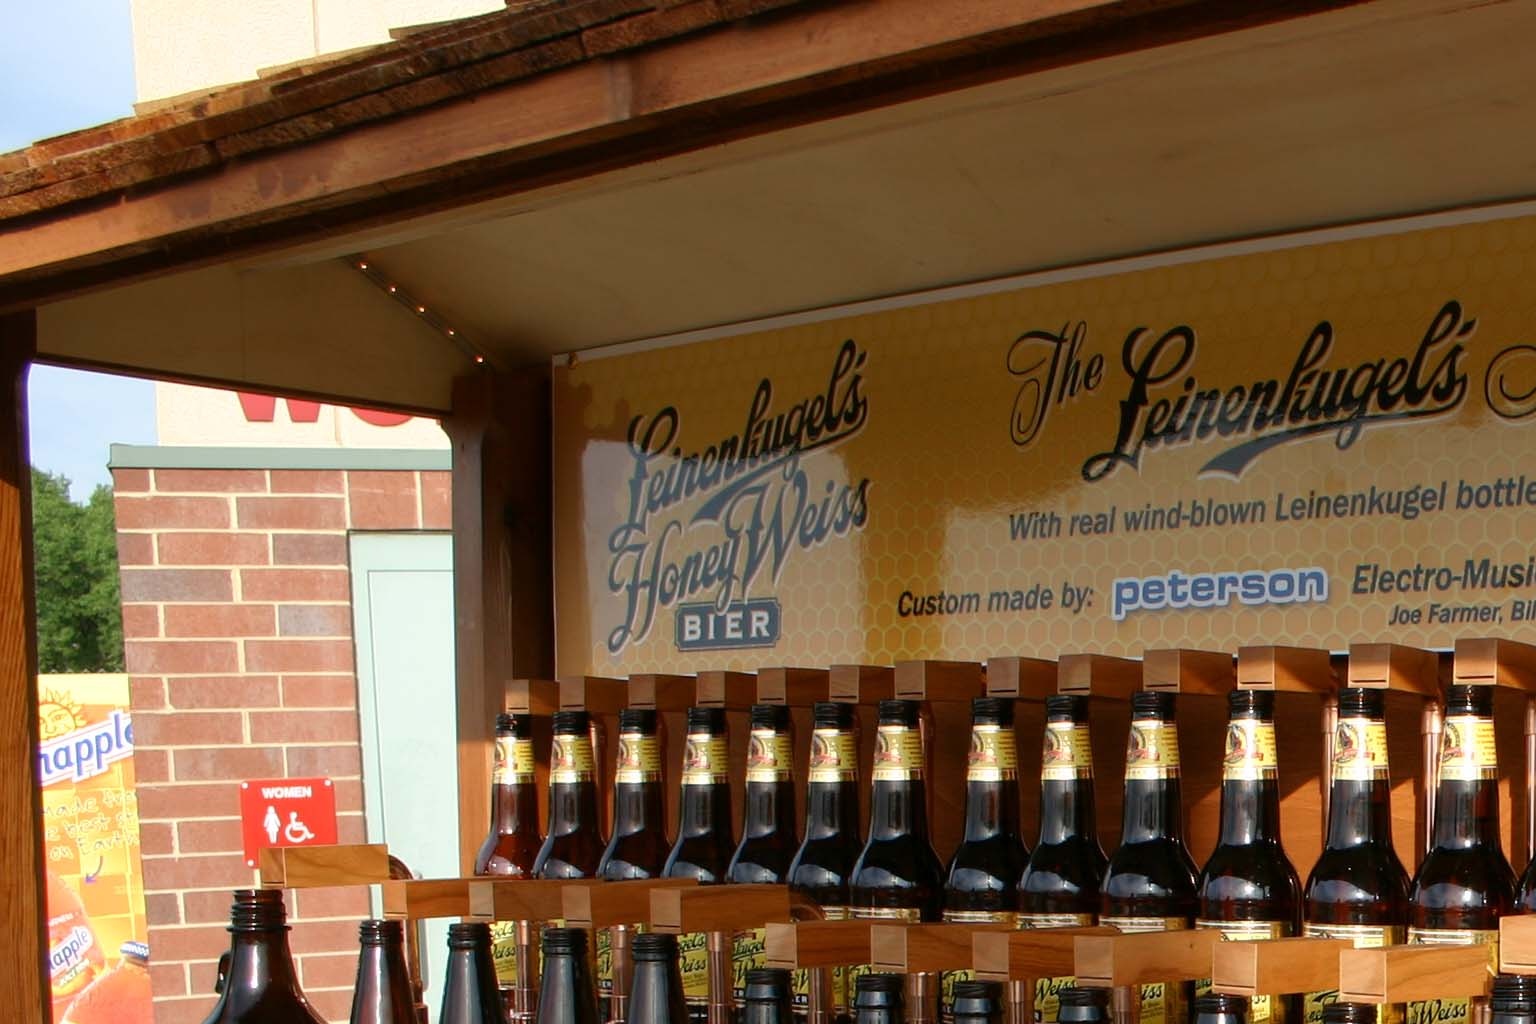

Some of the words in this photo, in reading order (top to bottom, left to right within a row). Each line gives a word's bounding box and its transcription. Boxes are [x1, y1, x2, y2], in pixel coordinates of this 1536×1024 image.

[1007, 320, 1106, 446] The
[1082, 300, 1478, 481] Leinenkugel's
[608, 338, 869, 551] Leinenkugel's
[1009, 511, 1064, 542] With
[1069, 507, 1116, 537] real
[1123, 498, 1265, 534] wind-blown
[1275, 482, 1447, 522] Leinenkugel
[608, 520, 739, 655] Honey
[724, 470, 869, 598] Weiss
[898, 588, 978, 619] Custom
[988, 582, 1052, 615] made
[1061, 584, 1095, 615] by:
[1113, 570, 1328, 618] peterson
[1387, 603, 1423, 626] Joe
[1428, 600, 1505, 625] Farmer,
[684, 612, 772, 643] BIER
[261, 785, 312, 801] WOMEN
